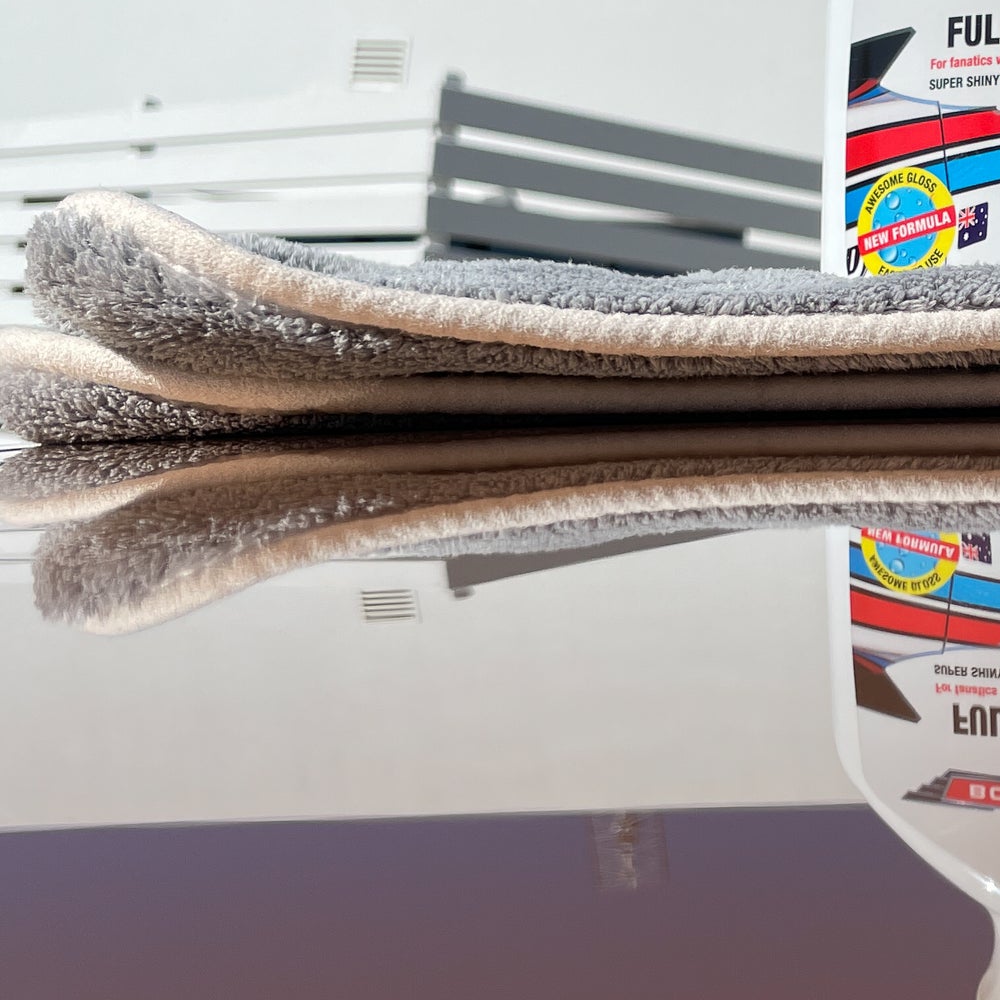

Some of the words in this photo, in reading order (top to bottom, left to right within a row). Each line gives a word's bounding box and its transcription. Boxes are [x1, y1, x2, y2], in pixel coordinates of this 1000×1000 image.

[930, 58, 947, 70] For
[950, 55, 993, 68] fanatics
[929, 77, 963, 91] SUPER
[966, 74, 1000, 88] SHINY
[865, 172, 904, 215] AWESOME
[906, 172, 937, 193] GLOSS
[863, 230, 890, 251] NEW
[892, 210, 952, 241] FORMULA
